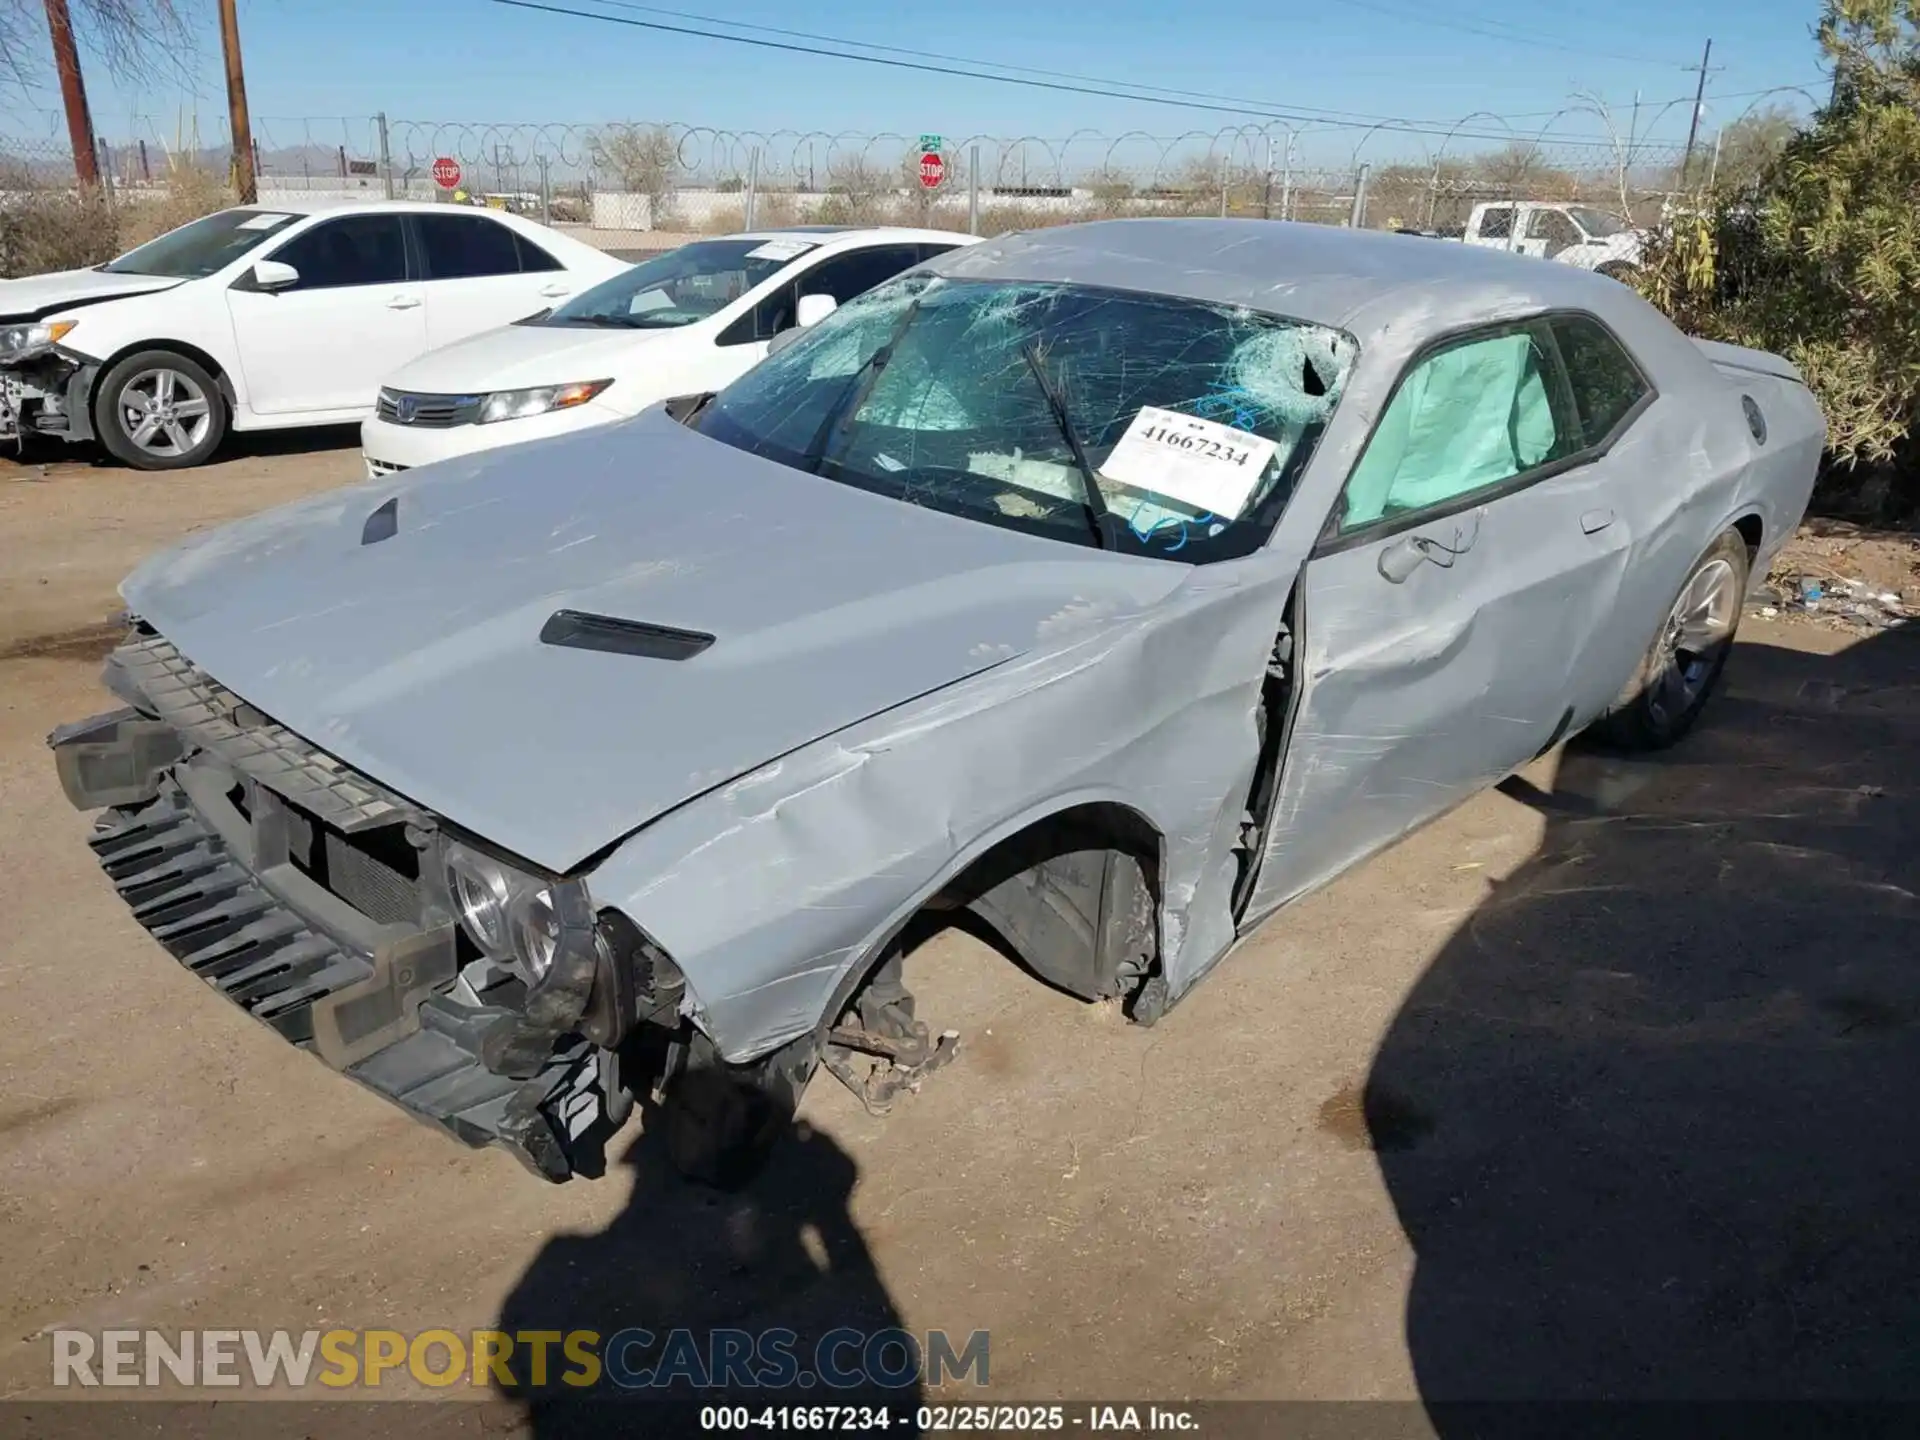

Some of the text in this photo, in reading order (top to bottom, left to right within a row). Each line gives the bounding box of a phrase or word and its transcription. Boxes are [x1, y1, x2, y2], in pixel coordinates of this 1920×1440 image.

[435, 166, 458, 178] STOP
[920, 163, 943, 177] STOP
[1141, 426, 1248, 466] 41667234
